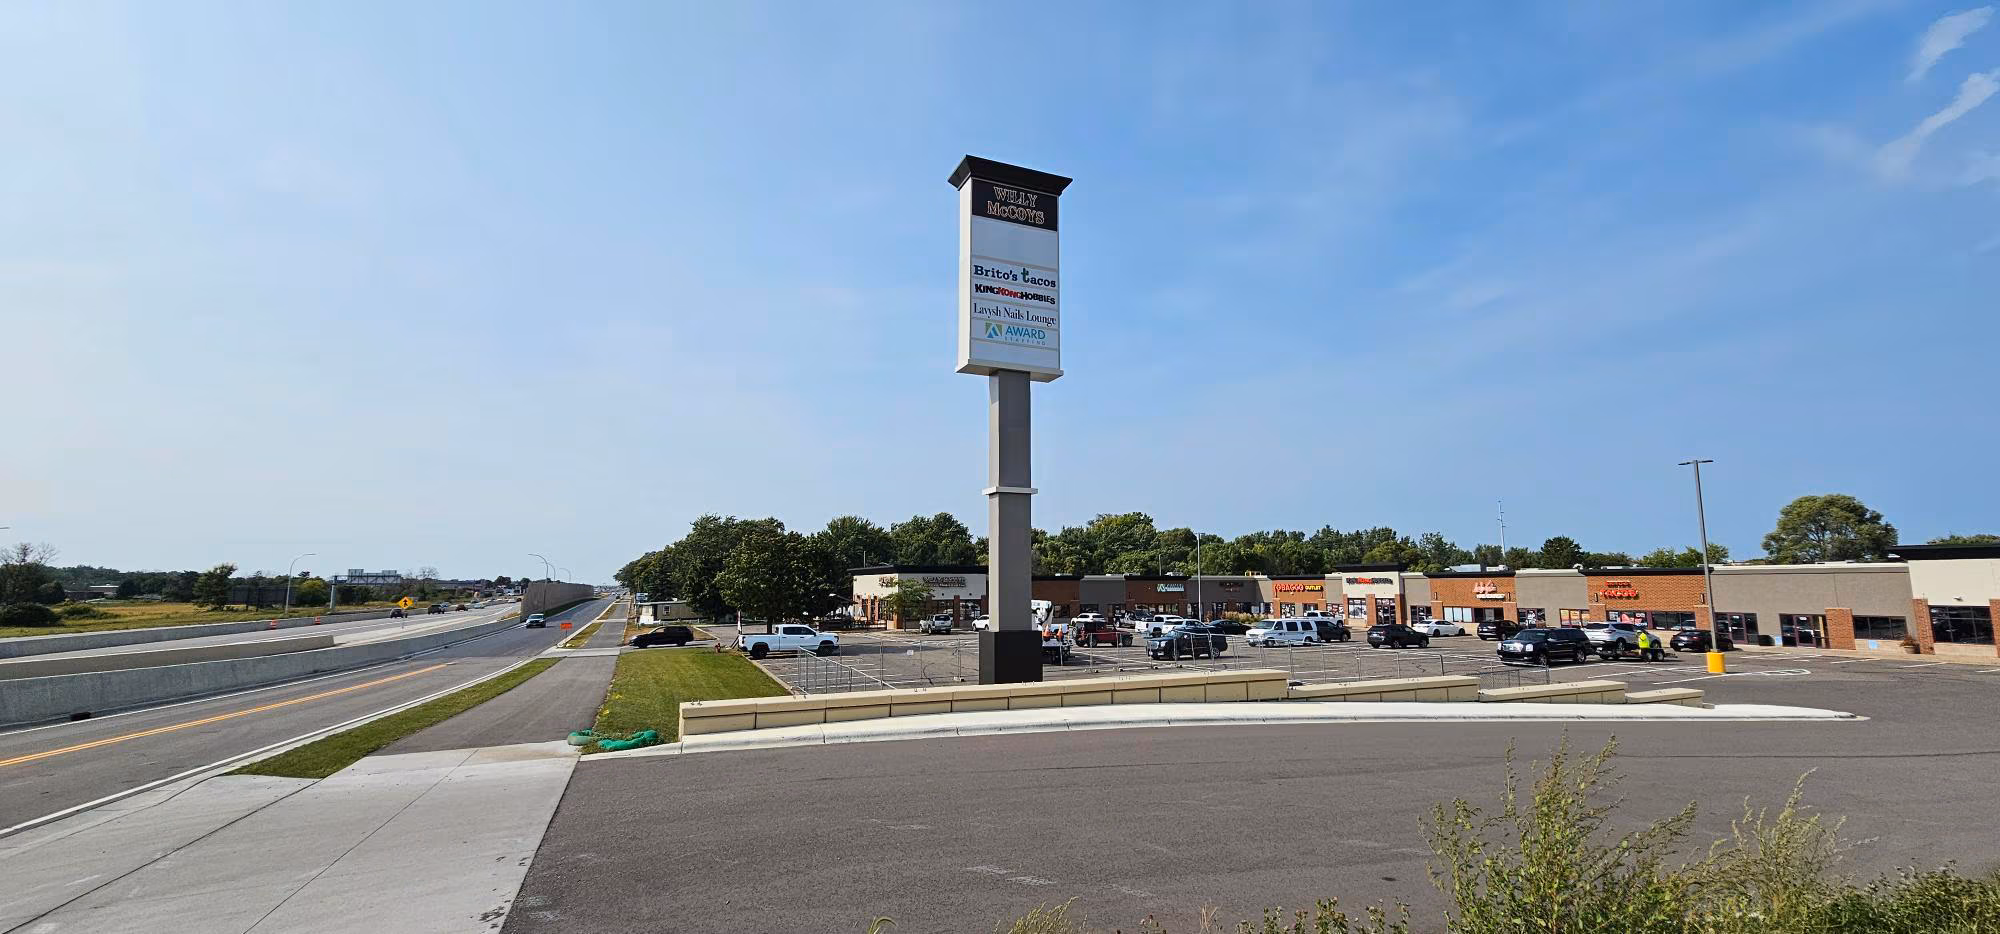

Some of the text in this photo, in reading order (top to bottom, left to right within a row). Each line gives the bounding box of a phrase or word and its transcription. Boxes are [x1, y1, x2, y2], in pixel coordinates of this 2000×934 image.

[993, 186, 1038, 208] WILLY
[973, 264, 1057, 288] Brito's tacos
[973, 302, 1057, 327] Lavysh Nails Lounge
[1005, 325, 1046, 340] AWARD
